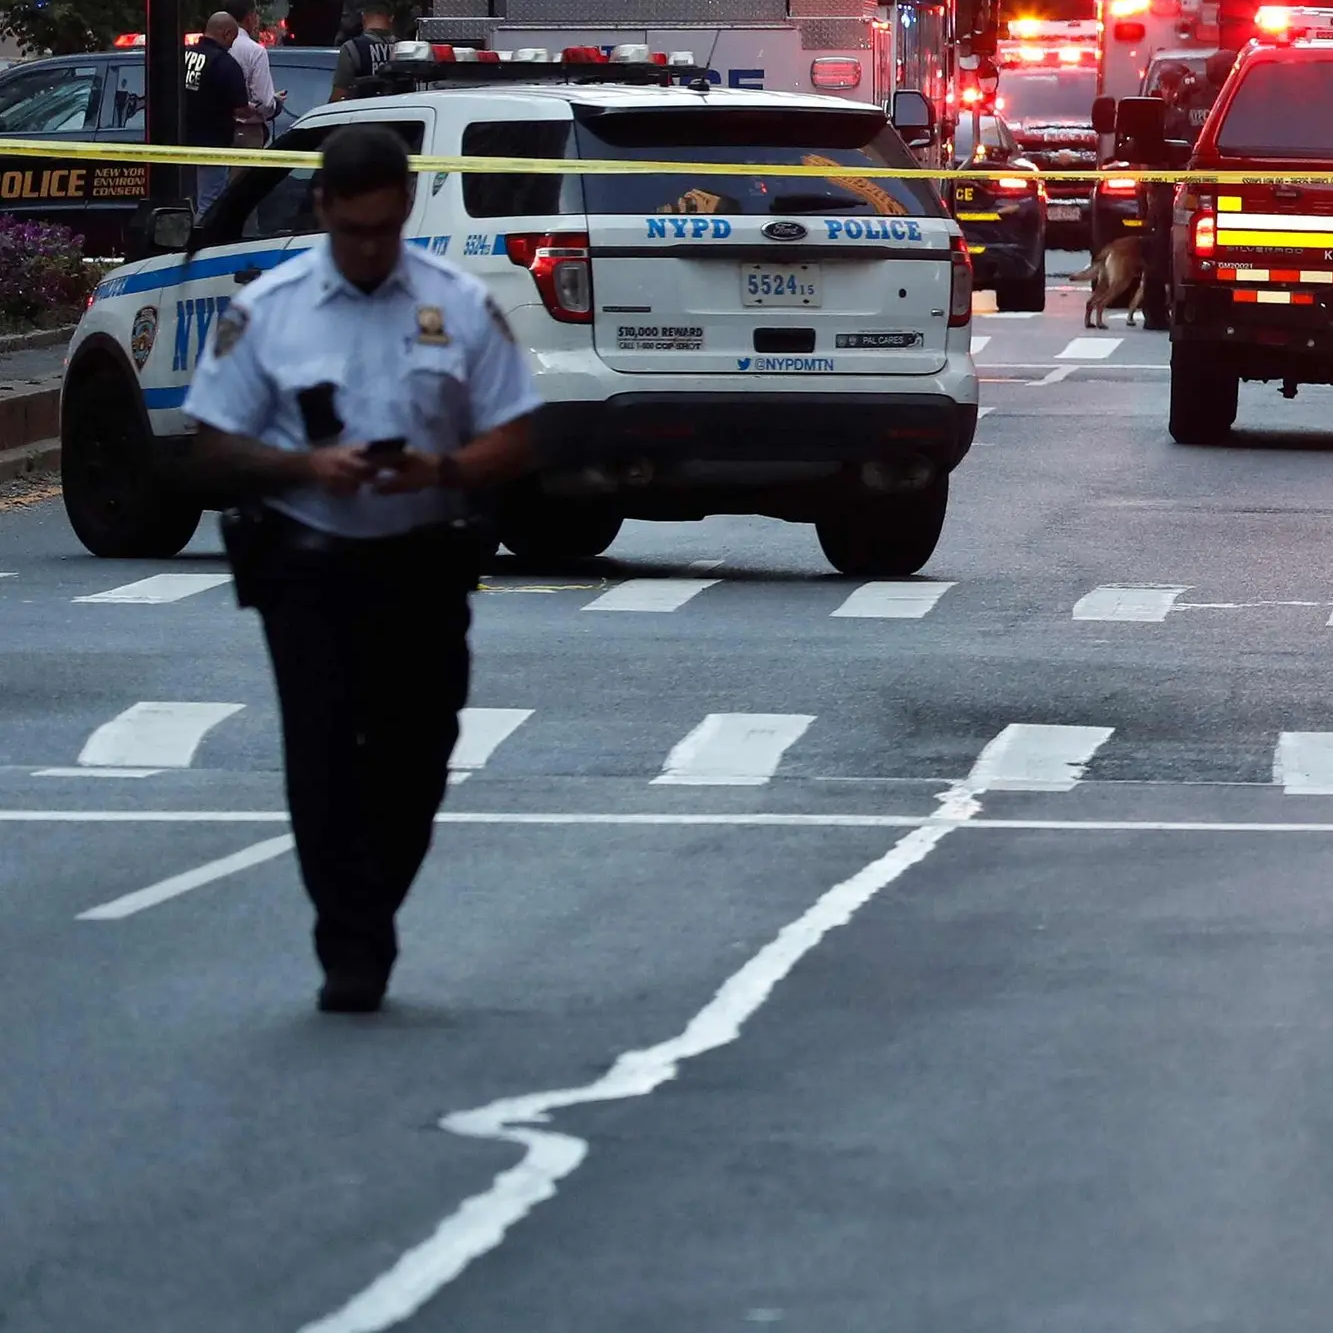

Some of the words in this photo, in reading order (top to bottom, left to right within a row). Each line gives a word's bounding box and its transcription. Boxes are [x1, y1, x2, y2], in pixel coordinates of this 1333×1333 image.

[94, 167, 121, 177] NEW
[122, 167, 145, 176] YOR
[0, 169, 87, 198] OLICE
[646, 218, 732, 240] NYPD
[773, 223, 798, 236] Ford
[824, 219, 923, 241] POLICE
[748, 274, 798, 296] 5524
[800, 284, 815, 296] 15
[618, 326, 658, 338] $10,000
[661, 327, 703, 338] REWARD
[862, 336, 877, 345] PAL
[878, 336, 904, 345] CARES
[754, 358, 834, 372] @NYPDMTN
